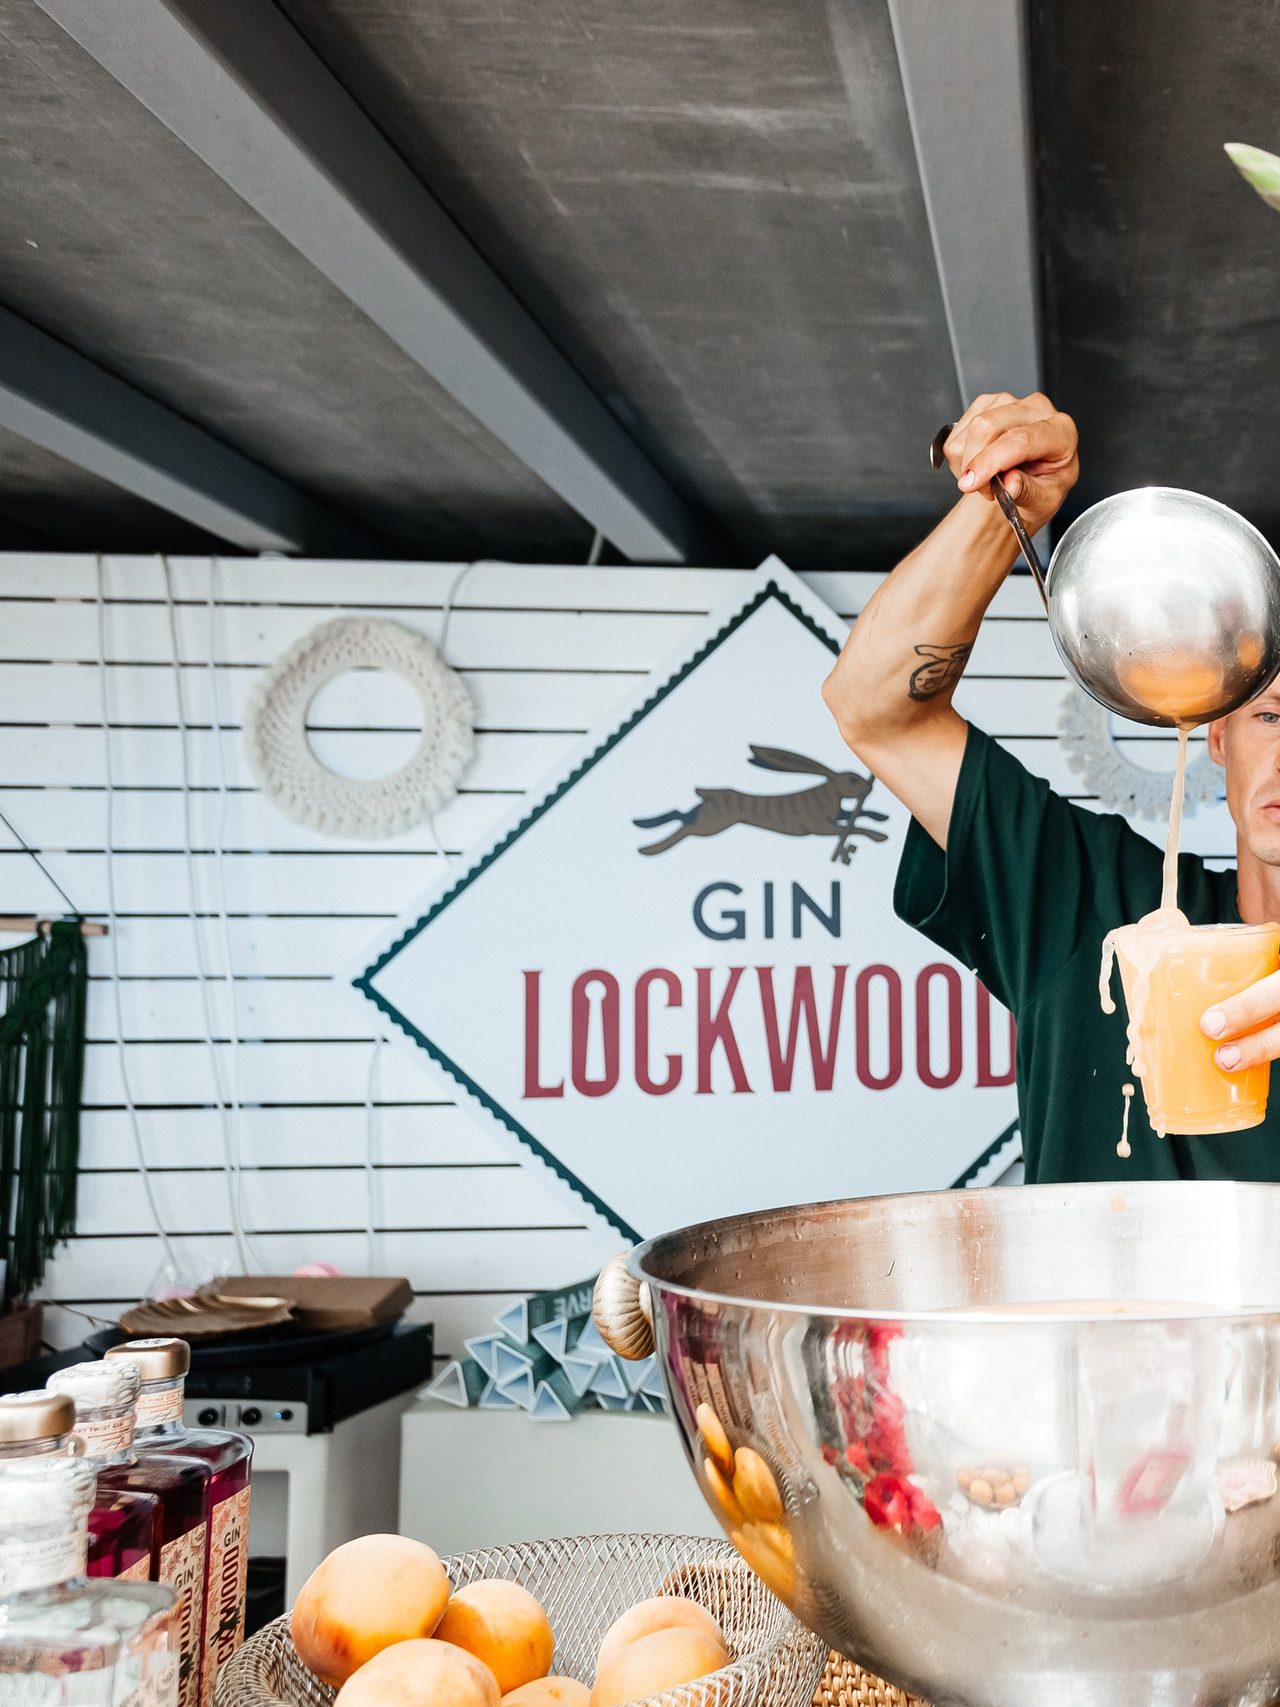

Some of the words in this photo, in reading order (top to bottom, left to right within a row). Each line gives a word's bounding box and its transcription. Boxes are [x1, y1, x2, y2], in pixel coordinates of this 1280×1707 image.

[693, 881, 841, 940] GIN
[522, 962, 1017, 1098] LOCKWOOD
[224, 1525, 241, 1547] GIN
